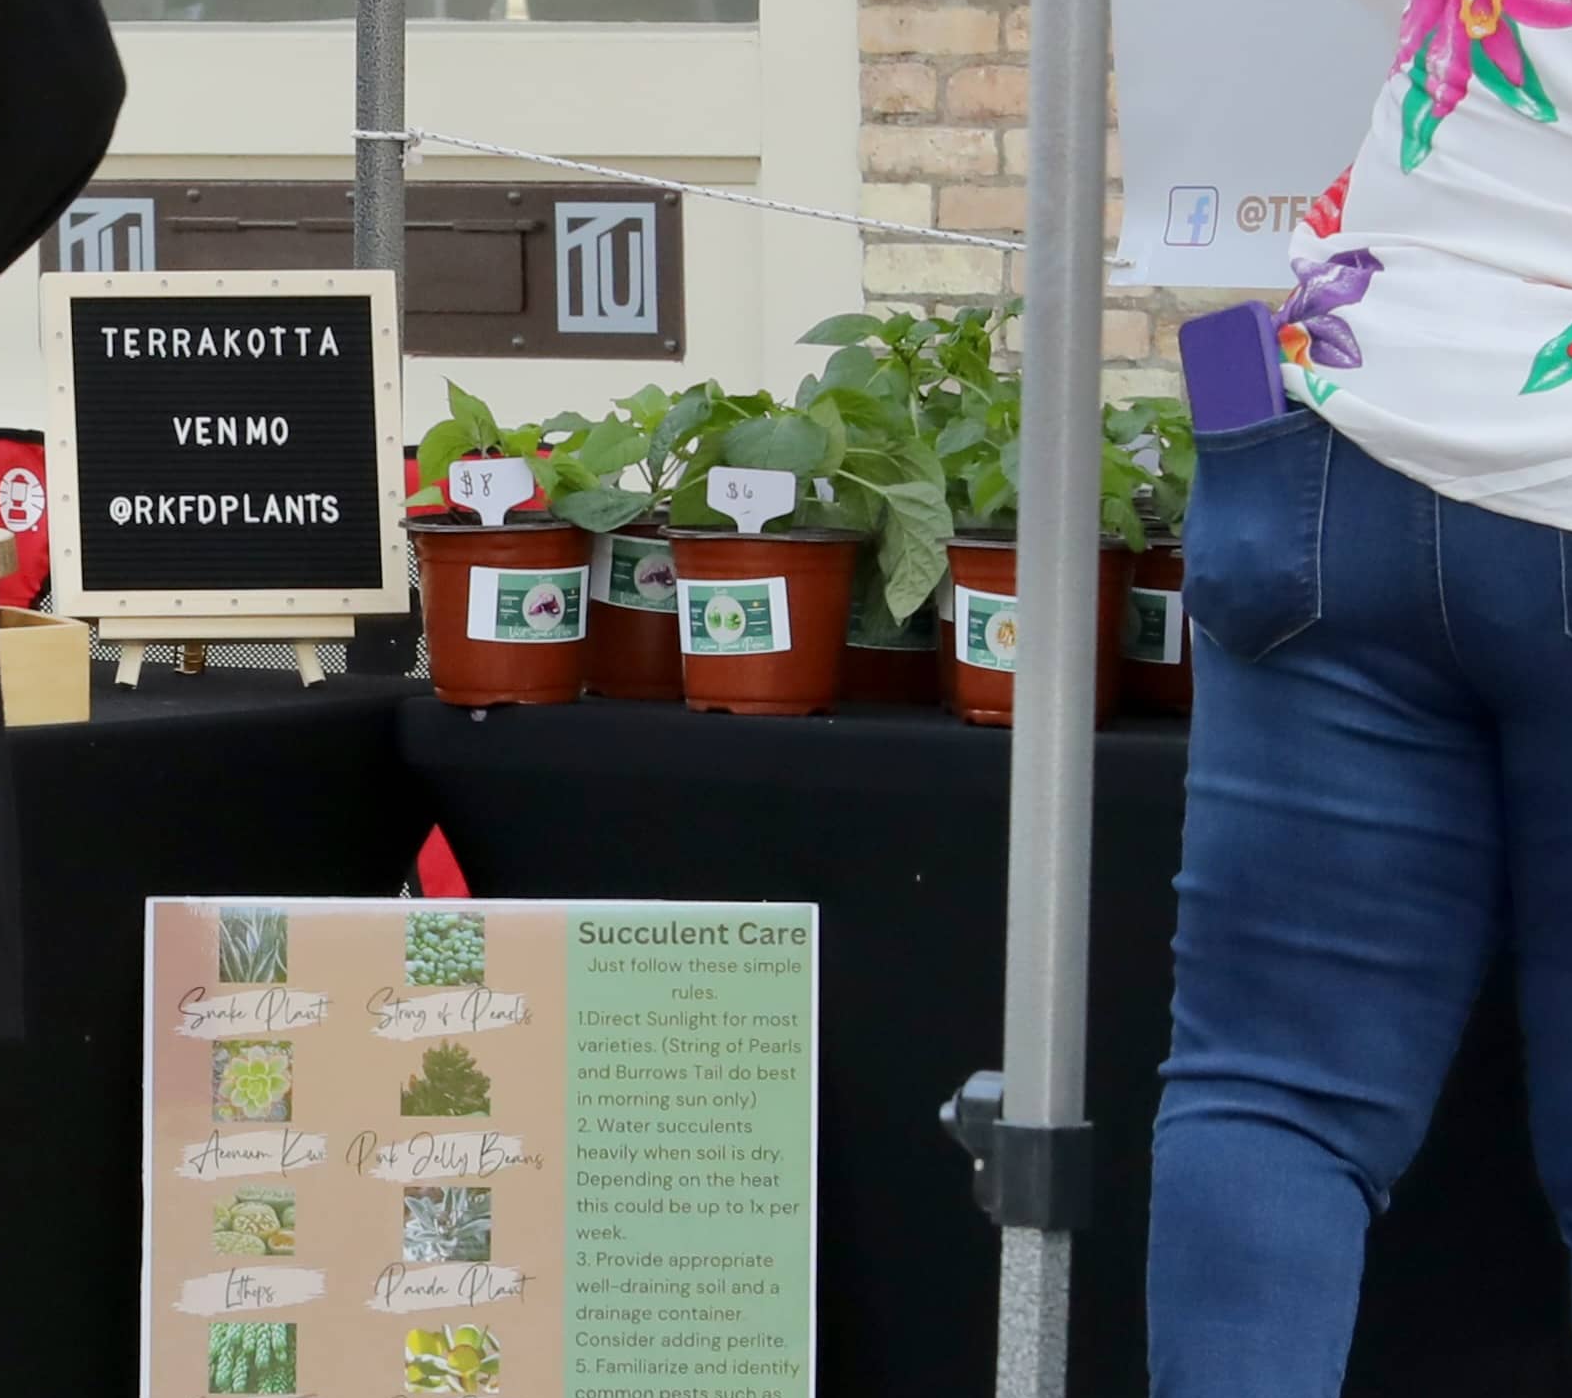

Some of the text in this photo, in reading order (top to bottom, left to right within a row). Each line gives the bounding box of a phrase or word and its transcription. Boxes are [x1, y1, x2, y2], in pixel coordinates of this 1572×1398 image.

[102, 327, 340, 358] TERRAKOTTA
[109, 494, 340, 526] @RKFDPLANTS
[579, 921, 806, 945] Succulent Care
[588, 957, 802, 976] Just follow these simple
[672, 984, 717, 1000] rules.
[178, 986, 334, 1031] Snake Plant
[648, 1011, 717, 1030] Sunlight
[723, 1011, 747, 1027] for
[753, 1013, 798, 1026] most
[662, 1037, 720, 1057] (String
[726, 1038, 743, 1053] of
[749, 1037, 802, 1052] Pearls
[578, 1064, 796, 1080] and Burrows Tail do best
[578, 1090, 756, 1111] in morning sun only)
[597, 1119, 650, 1134] Water
[657, 1118, 752, 1133] succulents
[577, 1144, 638, 1163] heavily
[644, 1144, 690, 1160] when
[697, 1145, 725, 1160] soil
[732, 1145, 744, 1160] is
[577, 1171, 779, 1191] Depending on the heat
[577, 1199, 608, 1214] this
[614, 1198, 663, 1214] could
[669, 1199, 691, 1214] be
[697, 1203, 720, 1218] up
[726, 1200, 744, 1214] to
[770, 1202, 800, 1217] per
[576, 1226, 626, 1241] week.
[576, 1252, 773, 1271] 3. Provide appropriate
[374, 1262, 536, 1308] Panda Plant
[576, 1278, 779, 1298] well-draining soil and a
[576, 1306, 652, 1324] drainage
[576, 1331, 655, 1348] Consider
[661, 1332, 721, 1352] adding
[576, 1358, 800, 1377] 5. Familiarize and identify
